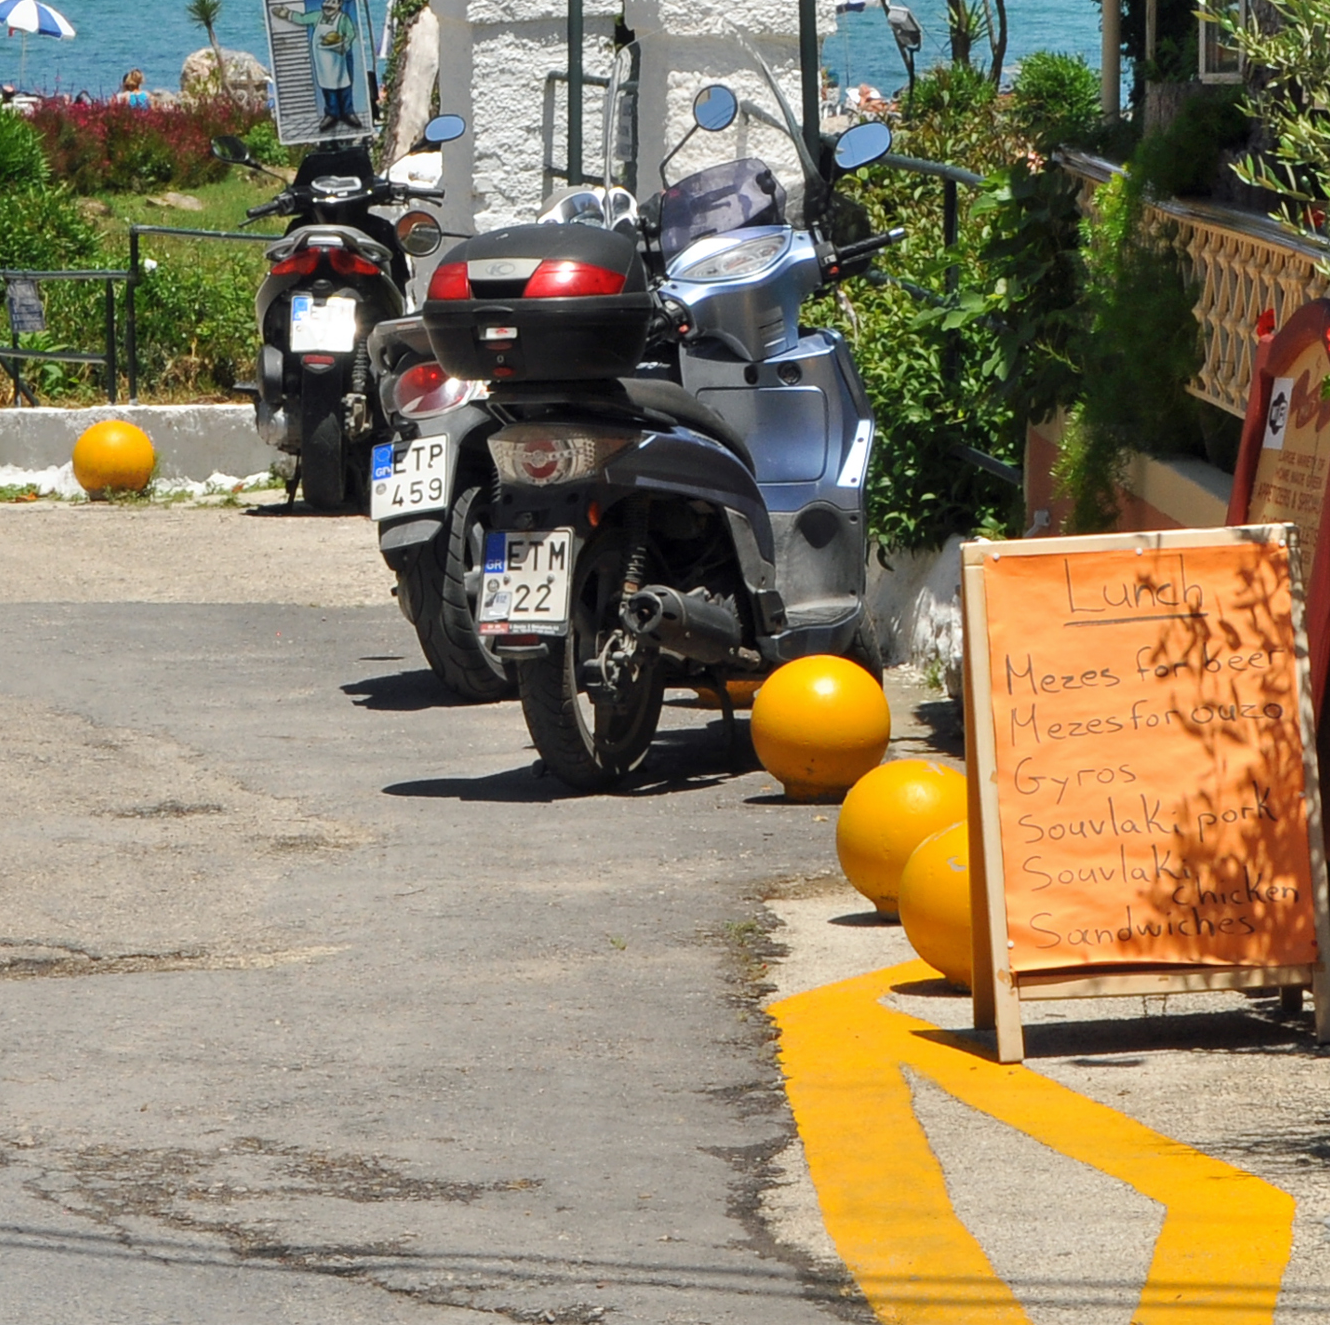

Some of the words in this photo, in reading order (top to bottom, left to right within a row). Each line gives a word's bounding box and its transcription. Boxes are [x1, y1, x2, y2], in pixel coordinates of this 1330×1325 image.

[393, 443, 443, 475] ETP
[392, 477, 443, 507] 459
[485, 560, 503, 571] GR
[507, 540, 566, 572] ETM
[513, 583, 552, 613] 22
[1064, 553, 1204, 615] Lunch
[1005, 653, 1121, 696] Mezes
[1135, 646, 1188, 682] for
[1200, 641, 1285, 674] beer
[1010, 703, 1124, 747] Mezes
[1129, 699, 1180, 731] for
[1190, 702, 1284, 725] ouzo
[1014, 756, 1137, 806] Gyros
[1197, 779, 1278, 843] pork
[1029, 905, 1256, 950] Sandwiches
